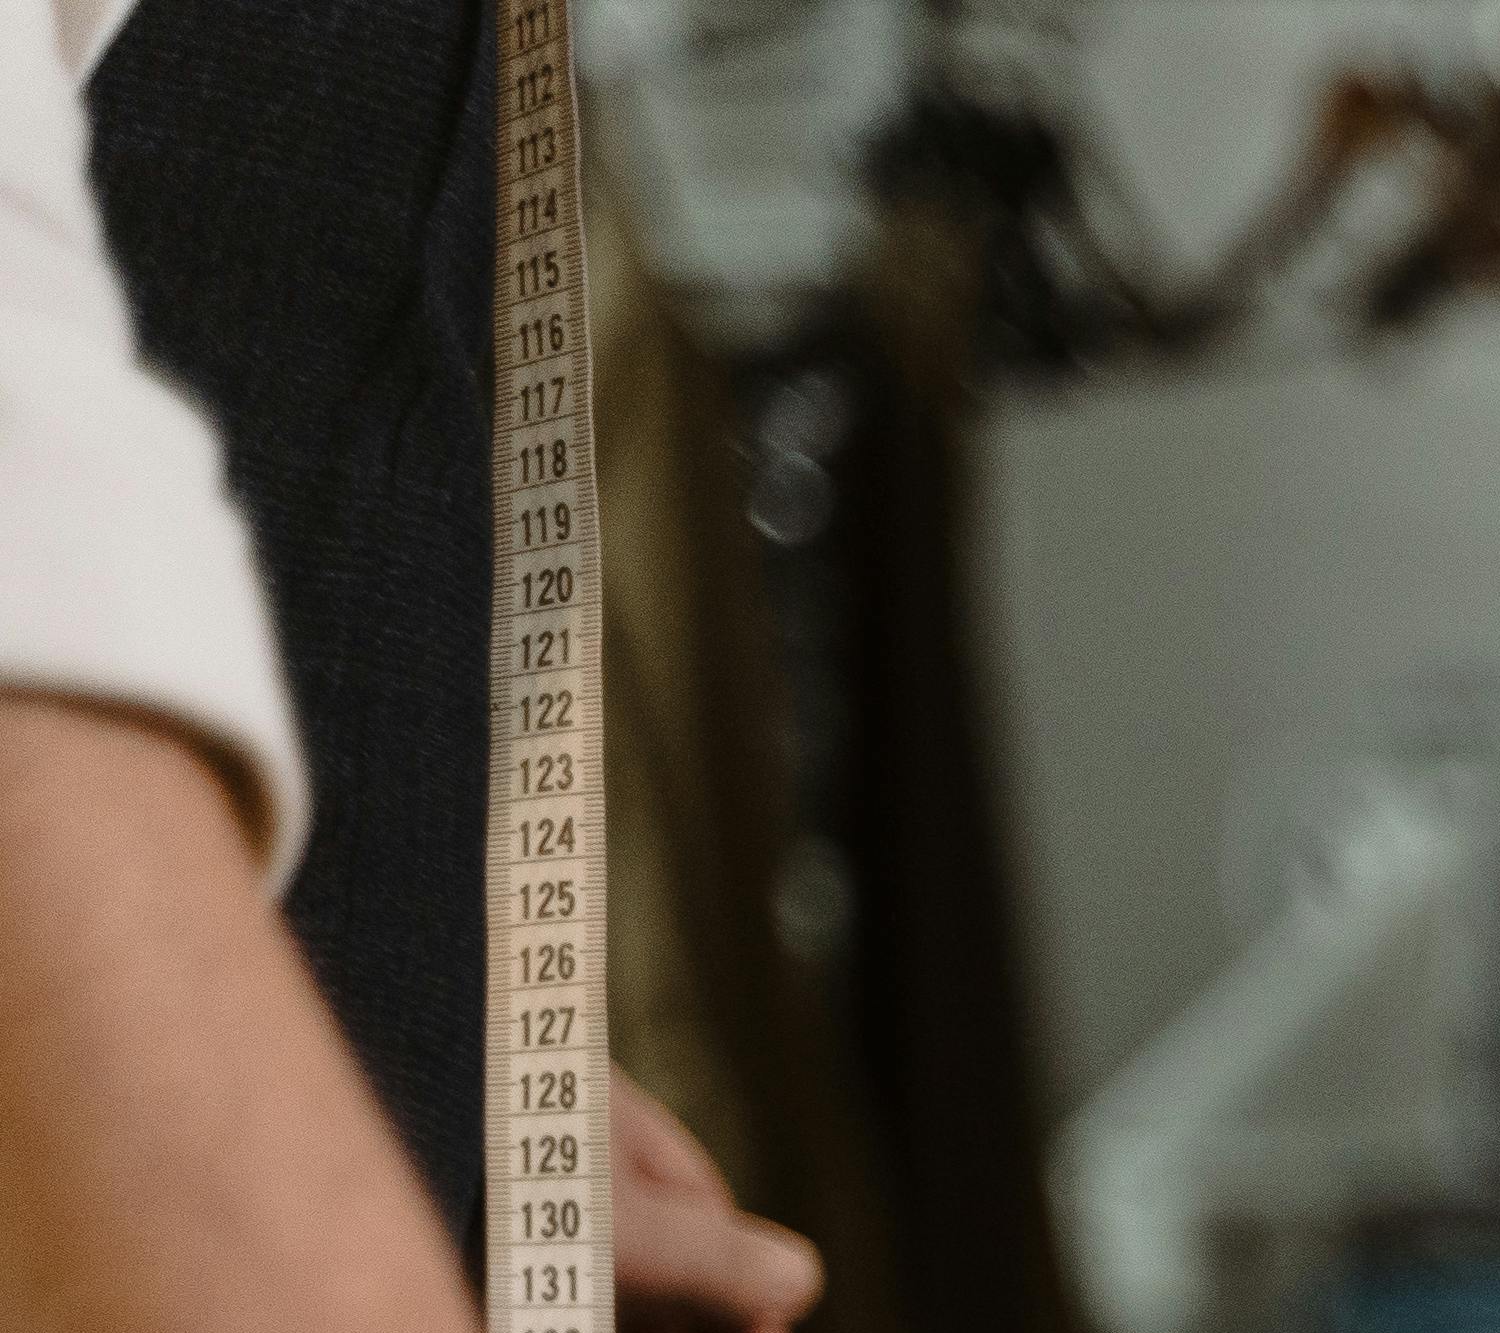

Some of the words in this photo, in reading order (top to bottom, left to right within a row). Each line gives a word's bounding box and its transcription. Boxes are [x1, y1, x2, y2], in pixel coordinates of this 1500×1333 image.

[516, 251, 559, 296] 115
[520, 313, 564, 359] 116
[520, 377, 564, 421] 117
[520, 439, 567, 483] 118
[521, 502, 571, 546] 119
[522, 566, 573, 608] 120
[521, 628, 570, 669] 121
[520, 690, 573, 732] 122
[520, 753, 574, 794] 123
[519, 816, 575, 857] 124
[519, 880, 575, 919] 125
[520, 942, 576, 983] 126
[520, 1006, 575, 1047] 127
[520, 1070, 577, 1110] 128
[519, 1134, 578, 1174] 129
[521, 1199, 580, 1239] 130
[522, 1264, 578, 1302] 131
